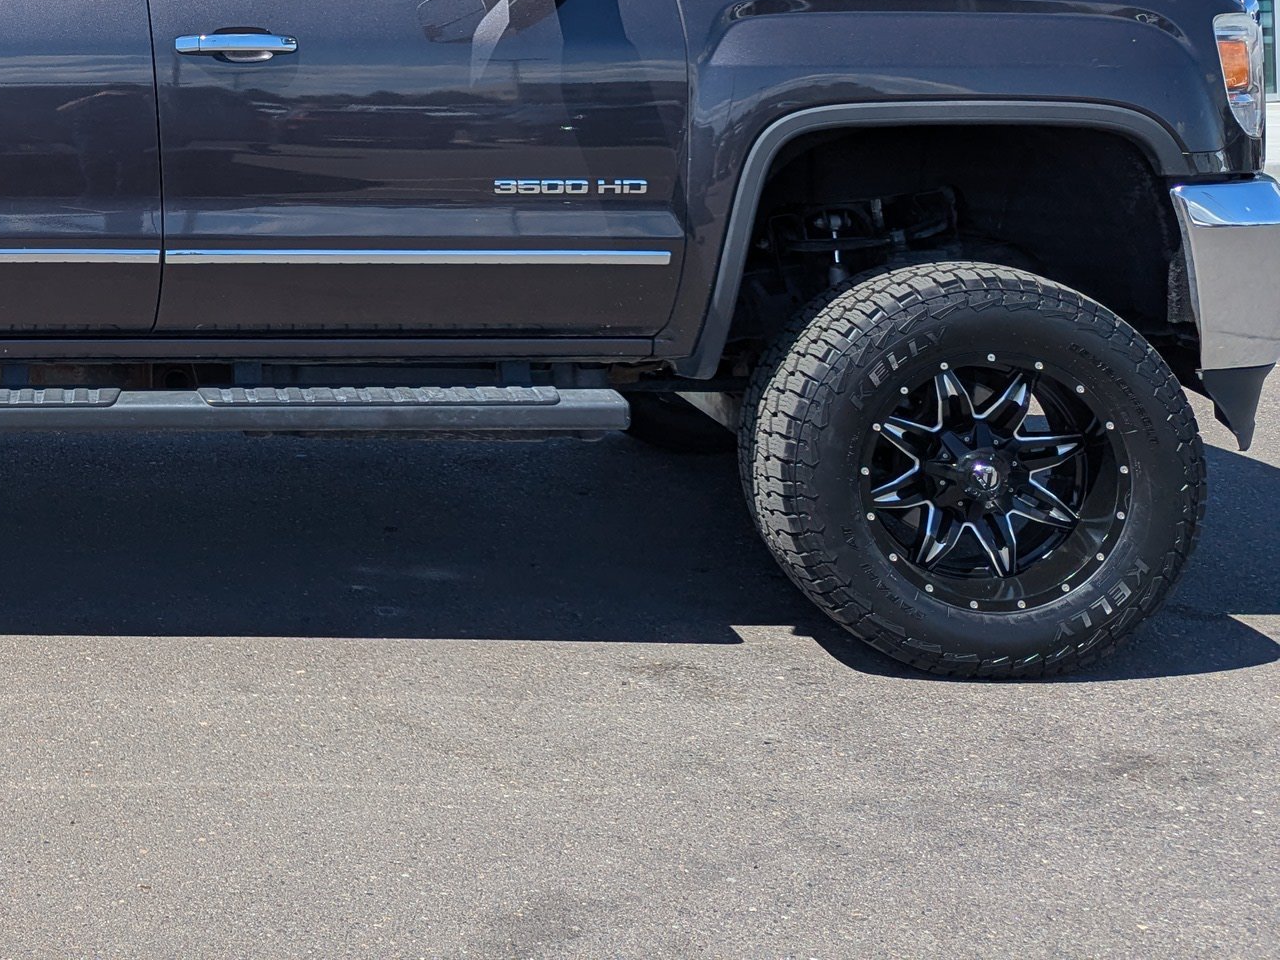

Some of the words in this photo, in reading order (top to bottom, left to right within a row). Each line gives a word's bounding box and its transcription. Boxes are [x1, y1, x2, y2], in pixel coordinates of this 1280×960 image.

[494, 179, 589, 194] 3500
[597, 179, 648, 194] HD
[849, 326, 947, 411] KELLY
[1053, 557, 1151, 642] KELLY
